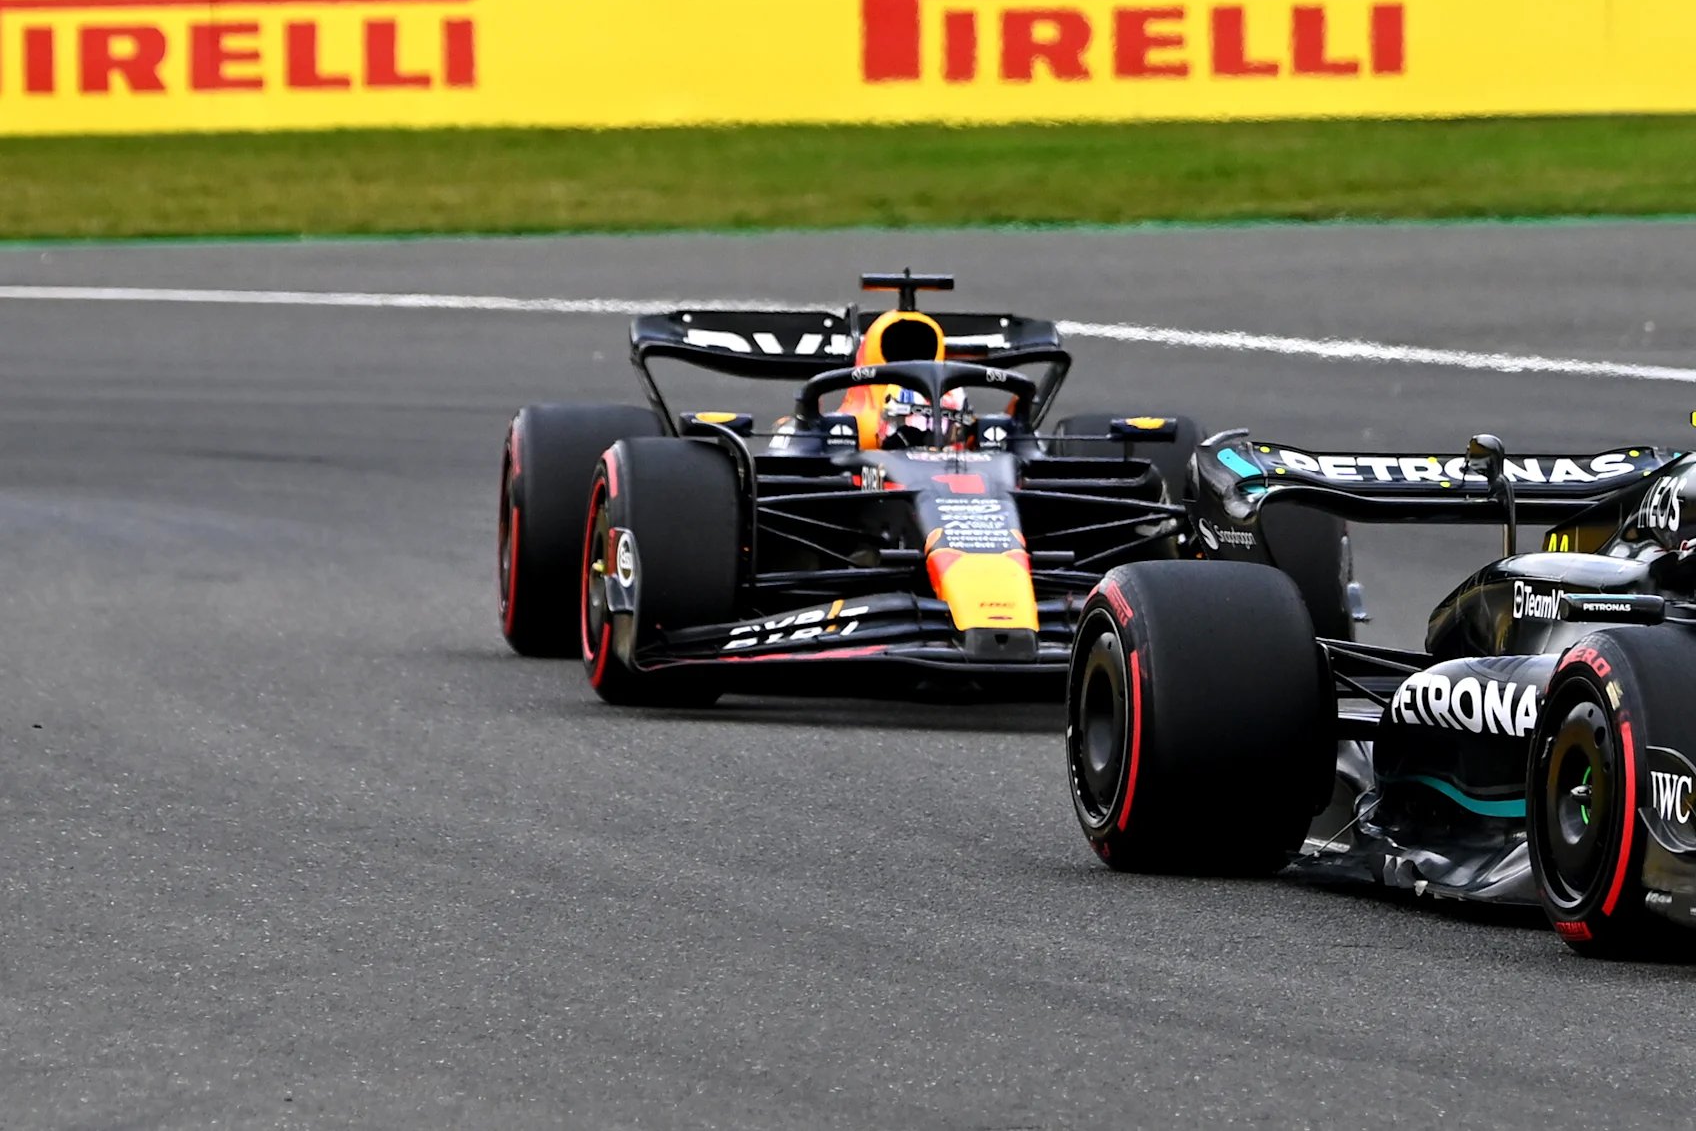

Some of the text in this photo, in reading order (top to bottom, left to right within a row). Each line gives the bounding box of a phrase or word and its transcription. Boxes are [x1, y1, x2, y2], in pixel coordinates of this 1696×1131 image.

[911, 405, 963, 423] ORCLE
[1637, 476, 1687, 532] INEOS
[1216, 524, 1257, 550] Snapdragon
[1583, 602, 1632, 612] PETRONAS
[1391, 672, 1538, 737] PETRONA
[1650, 770, 1692, 824] IWC
